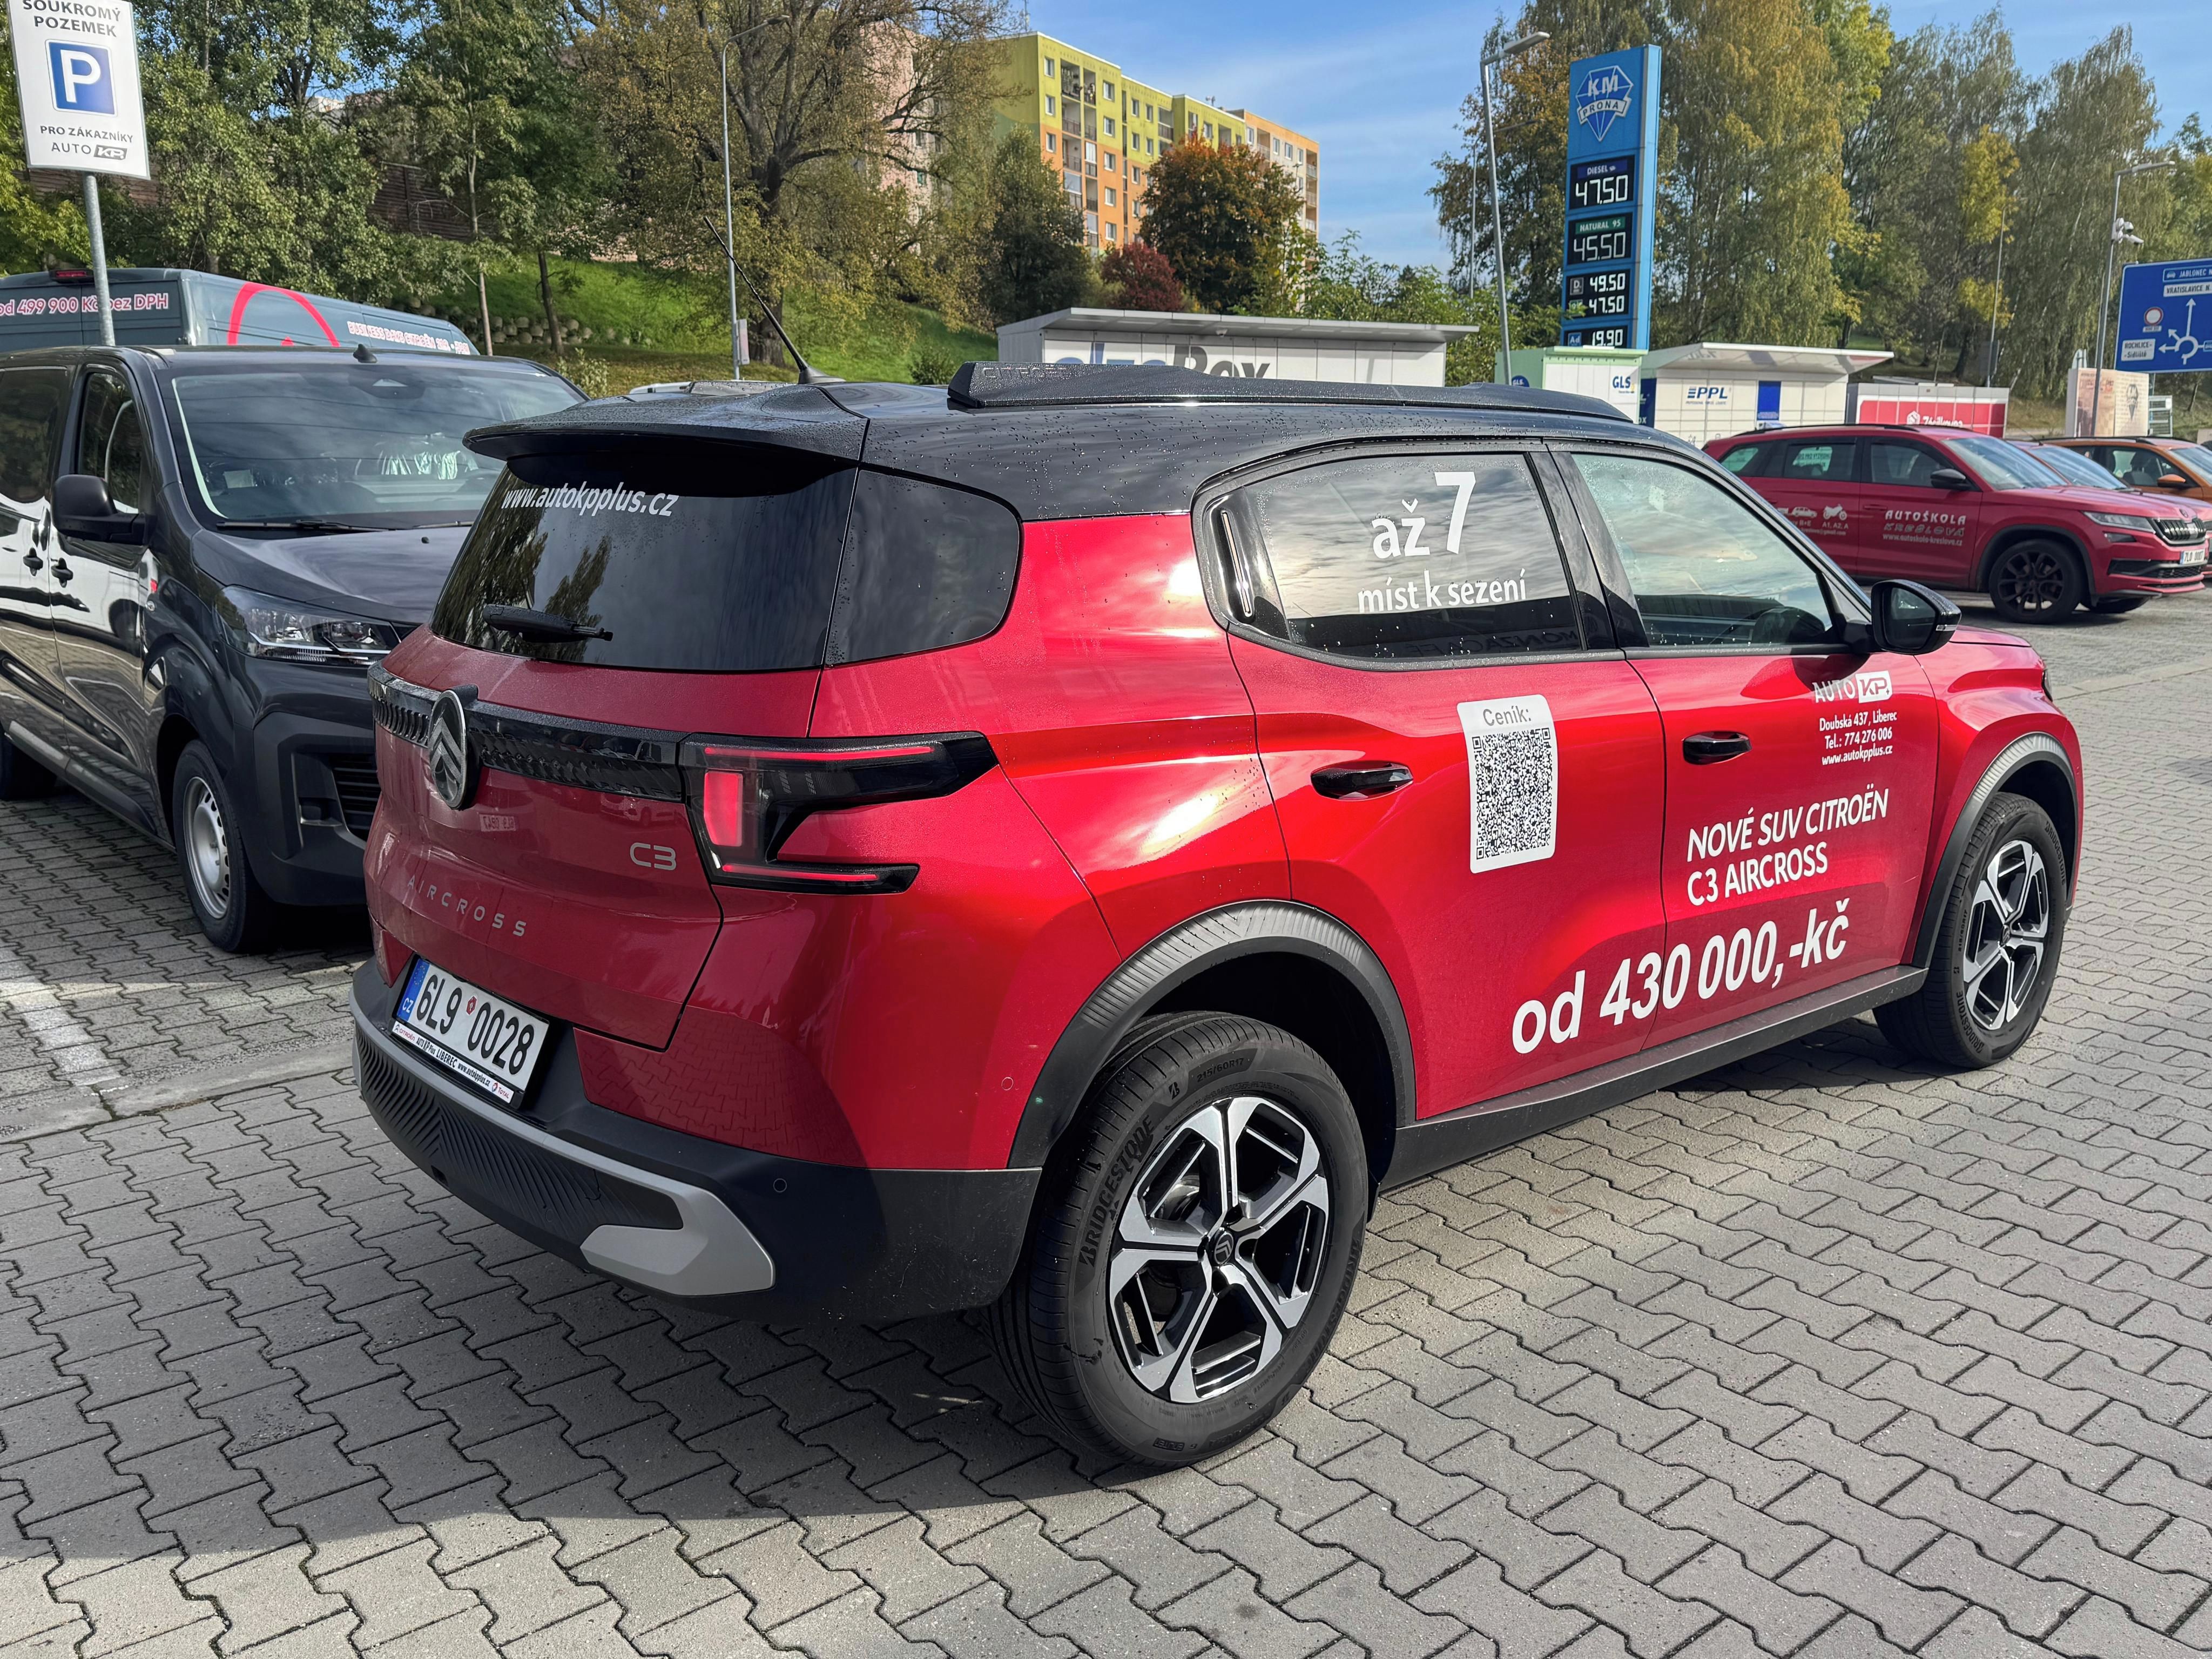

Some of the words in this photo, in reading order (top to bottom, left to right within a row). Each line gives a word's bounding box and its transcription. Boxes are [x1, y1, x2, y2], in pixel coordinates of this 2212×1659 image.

[23, 0, 121, 22] SOUKROMÝ
[33, 16, 117, 37] POZEMEK
[60, 49, 102, 104] P
[1588, 75, 1619, 97] KM
[1582, 99, 1620, 117] PRONA
[40, 125, 65, 135] PRO
[69, 127, 133, 143] ZÁKAZNÍKY
[51, 142, 91, 154] AUTO
[1587, 164, 1608, 176] DIESEL
[1580, 220, 1609, 232] NATURAL
[1612, 219, 1621, 228] 95
[2179, 268, 2207, 278] JABLONEC
[2167, 285, 2203, 294] VRATISLAVICE
[17, 298, 46, 315] 499
[48, 296, 78, 313] 900
[134, 293, 168, 310] DPH
[1613, 376, 1631, 388] GLS
[1696, 387, 1728, 399] PPL
[501, 481, 679, 517] www.autokpplus.cz
[1371, 498, 1431, 559] až
[1434, 471, 1476, 554] 7
[1885, 510, 1966, 525] AUTOŠKOLA
[1358, 576, 1420, 614] míst
[1424, 569, 1442, 608] k
[1448, 568, 1526, 606] sezení
[1812, 678, 1856, 703] AUTO
[1483, 706, 1532, 726] Ceník:
[1819, 714, 1852, 732] Doubská
[1872, 709, 1897, 724] Liberec
[1825, 733, 1842, 750] Tel.:
[1844, 731, 1860, 747] 774
[1862, 729, 1876, 744] 276
[1878, 726, 1893, 741] 006
[1822, 743, 1893, 766] www.autokpplus.cz
[1687, 807, 1755, 862] NOVÉ
[1757, 806, 1804, 846] SUV
[1805, 783, 1889, 835] CITROËN
[629, 841, 677, 871] C3
[1687, 867, 1719, 906] C3
[1724, 841, 1829, 898] AIRCROSS
[407, 874, 527, 938] AIRCROSS
[402, 997, 415, 1013] CZ
[1512, 970, 1586, 1055] od
[1599, 943, 1692, 1026] 430
[416, 974, 462, 1035] 6L9
[467, 1002, 535, 1075] 0028
[436, 1048, 458, 1068] LIBEREC
[1196, 1057, 1245, 1083] 215/60R17
[1079, 1114, 1155, 1268] BRIDGESTONE
